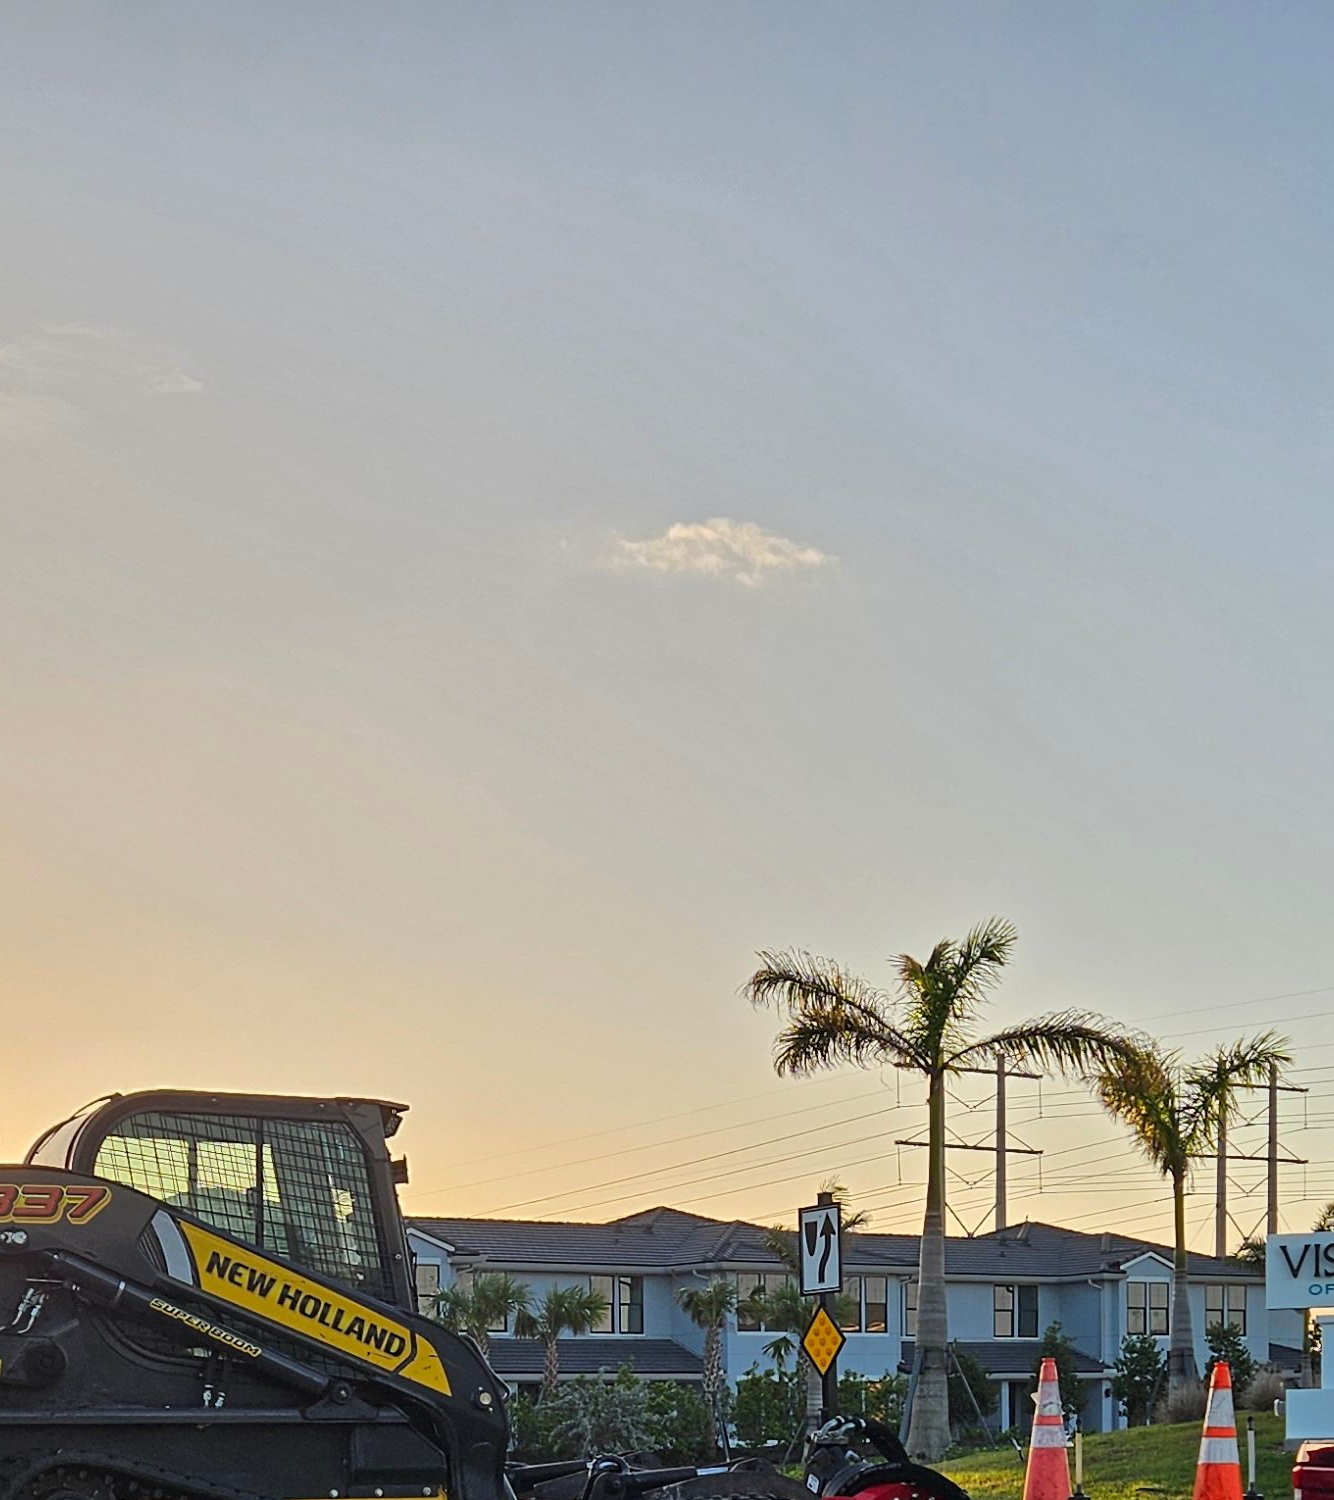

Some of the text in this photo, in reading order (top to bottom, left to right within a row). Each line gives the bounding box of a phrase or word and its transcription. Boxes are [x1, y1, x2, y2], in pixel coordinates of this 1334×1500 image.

[149, 1298, 262, 1358] SUPER BOOM
[205, 1251, 406, 1358] NEW HOLLAND
